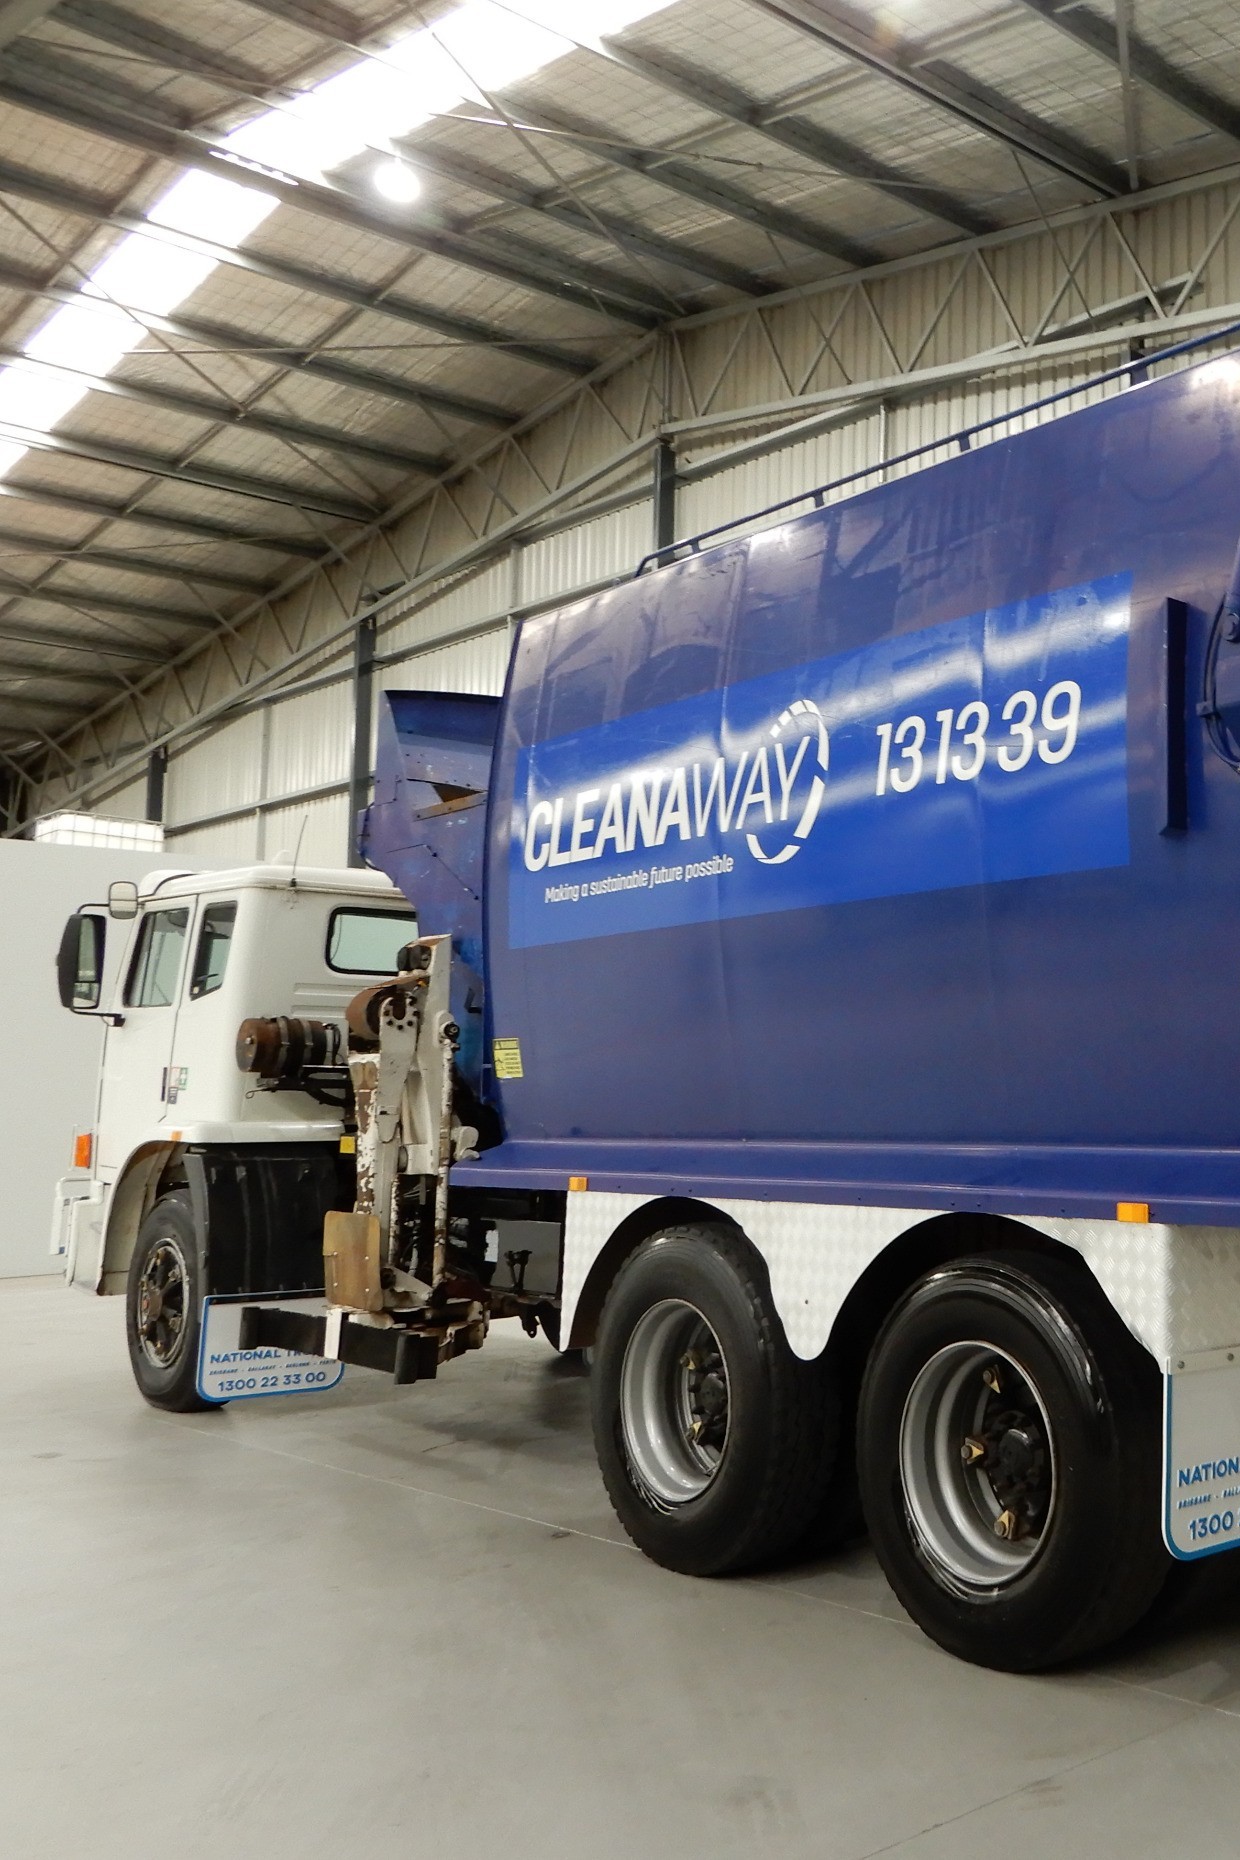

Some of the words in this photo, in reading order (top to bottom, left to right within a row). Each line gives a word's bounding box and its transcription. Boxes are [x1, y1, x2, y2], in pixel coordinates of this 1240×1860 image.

[524, 736, 810, 872] CLEANAWAY
[545, 883, 579, 903] Making
[581, 883, 588, 896] a
[590, 869, 649, 896] sustainable
[649, 863, 683, 888] future
[685, 854, 734, 882] possible
[210, 1350, 281, 1364] NATIONAL
[218, 1378, 256, 1392] 1300
[261, 1376, 278, 1388] 22
[283, 1373, 301, 1386] 33
[305, 1371, 326, 1383] 00
[1189, 1511, 1234, 1541] 1300
